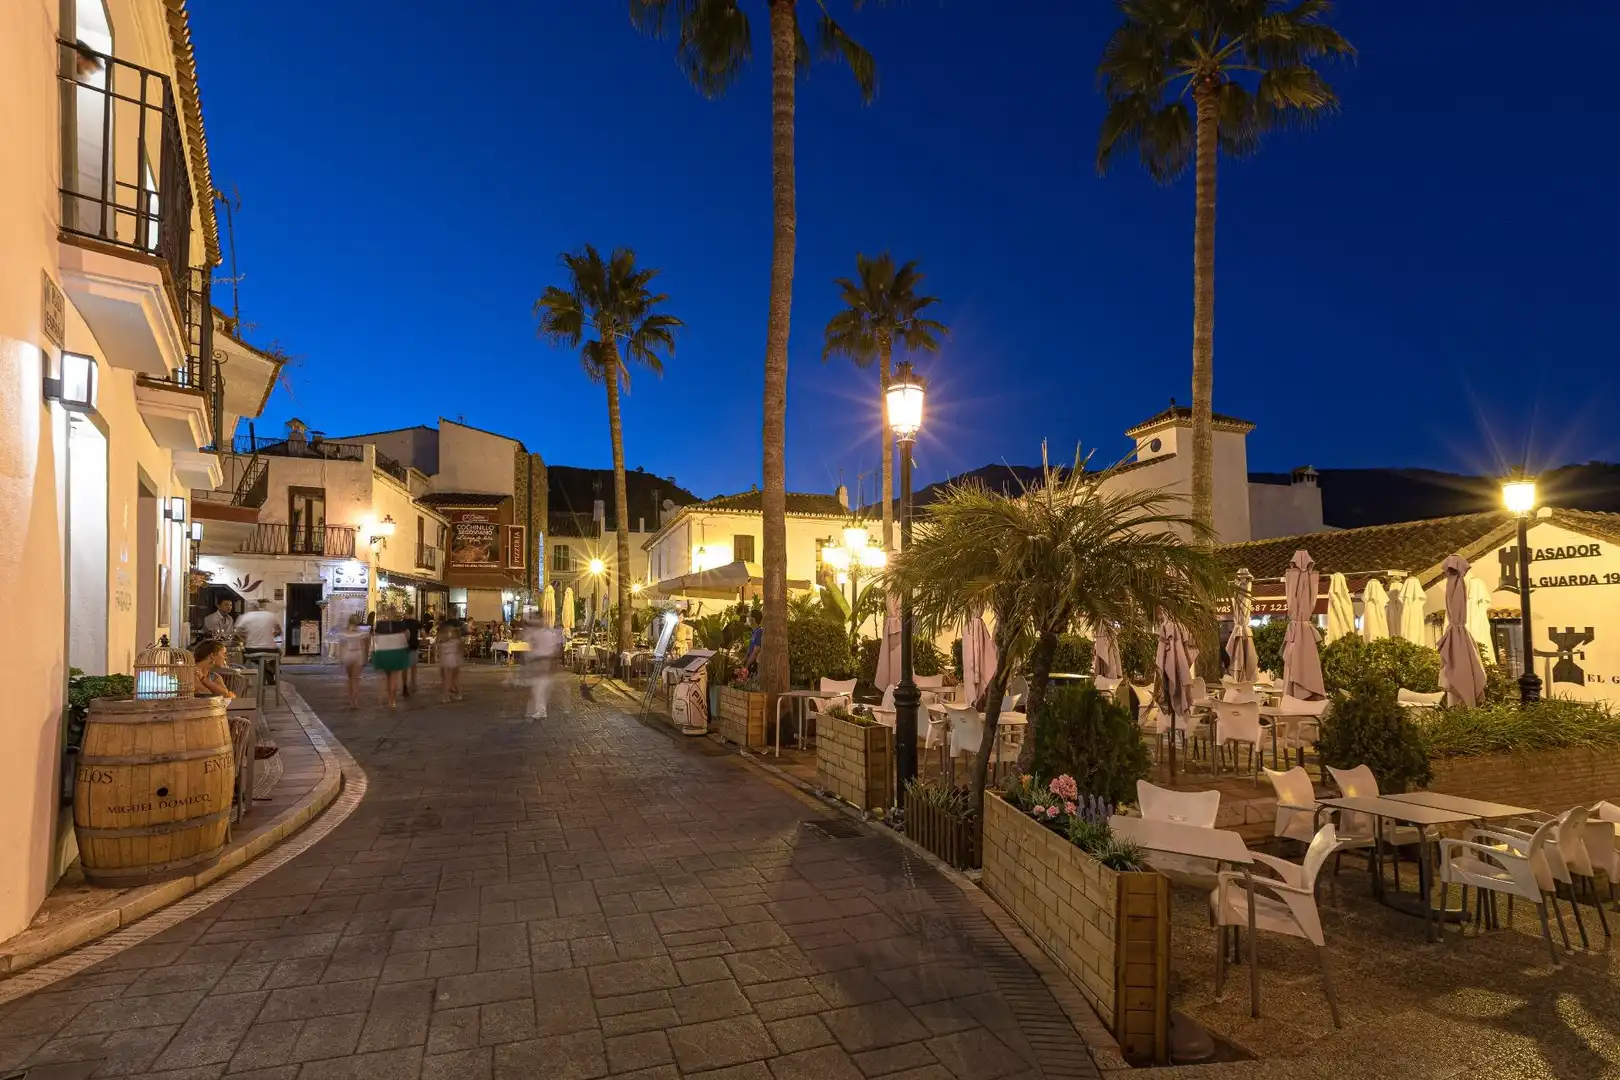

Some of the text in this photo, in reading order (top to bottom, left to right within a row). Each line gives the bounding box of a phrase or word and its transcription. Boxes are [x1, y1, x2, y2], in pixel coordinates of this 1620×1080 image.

[1535, 544, 1602, 560] ASADOR
[1540, 575, 1598, 587] GUARDA
[1587, 673, 1606, 684] EL
[107, 794, 212, 814] MIGUEL DOMECQ
